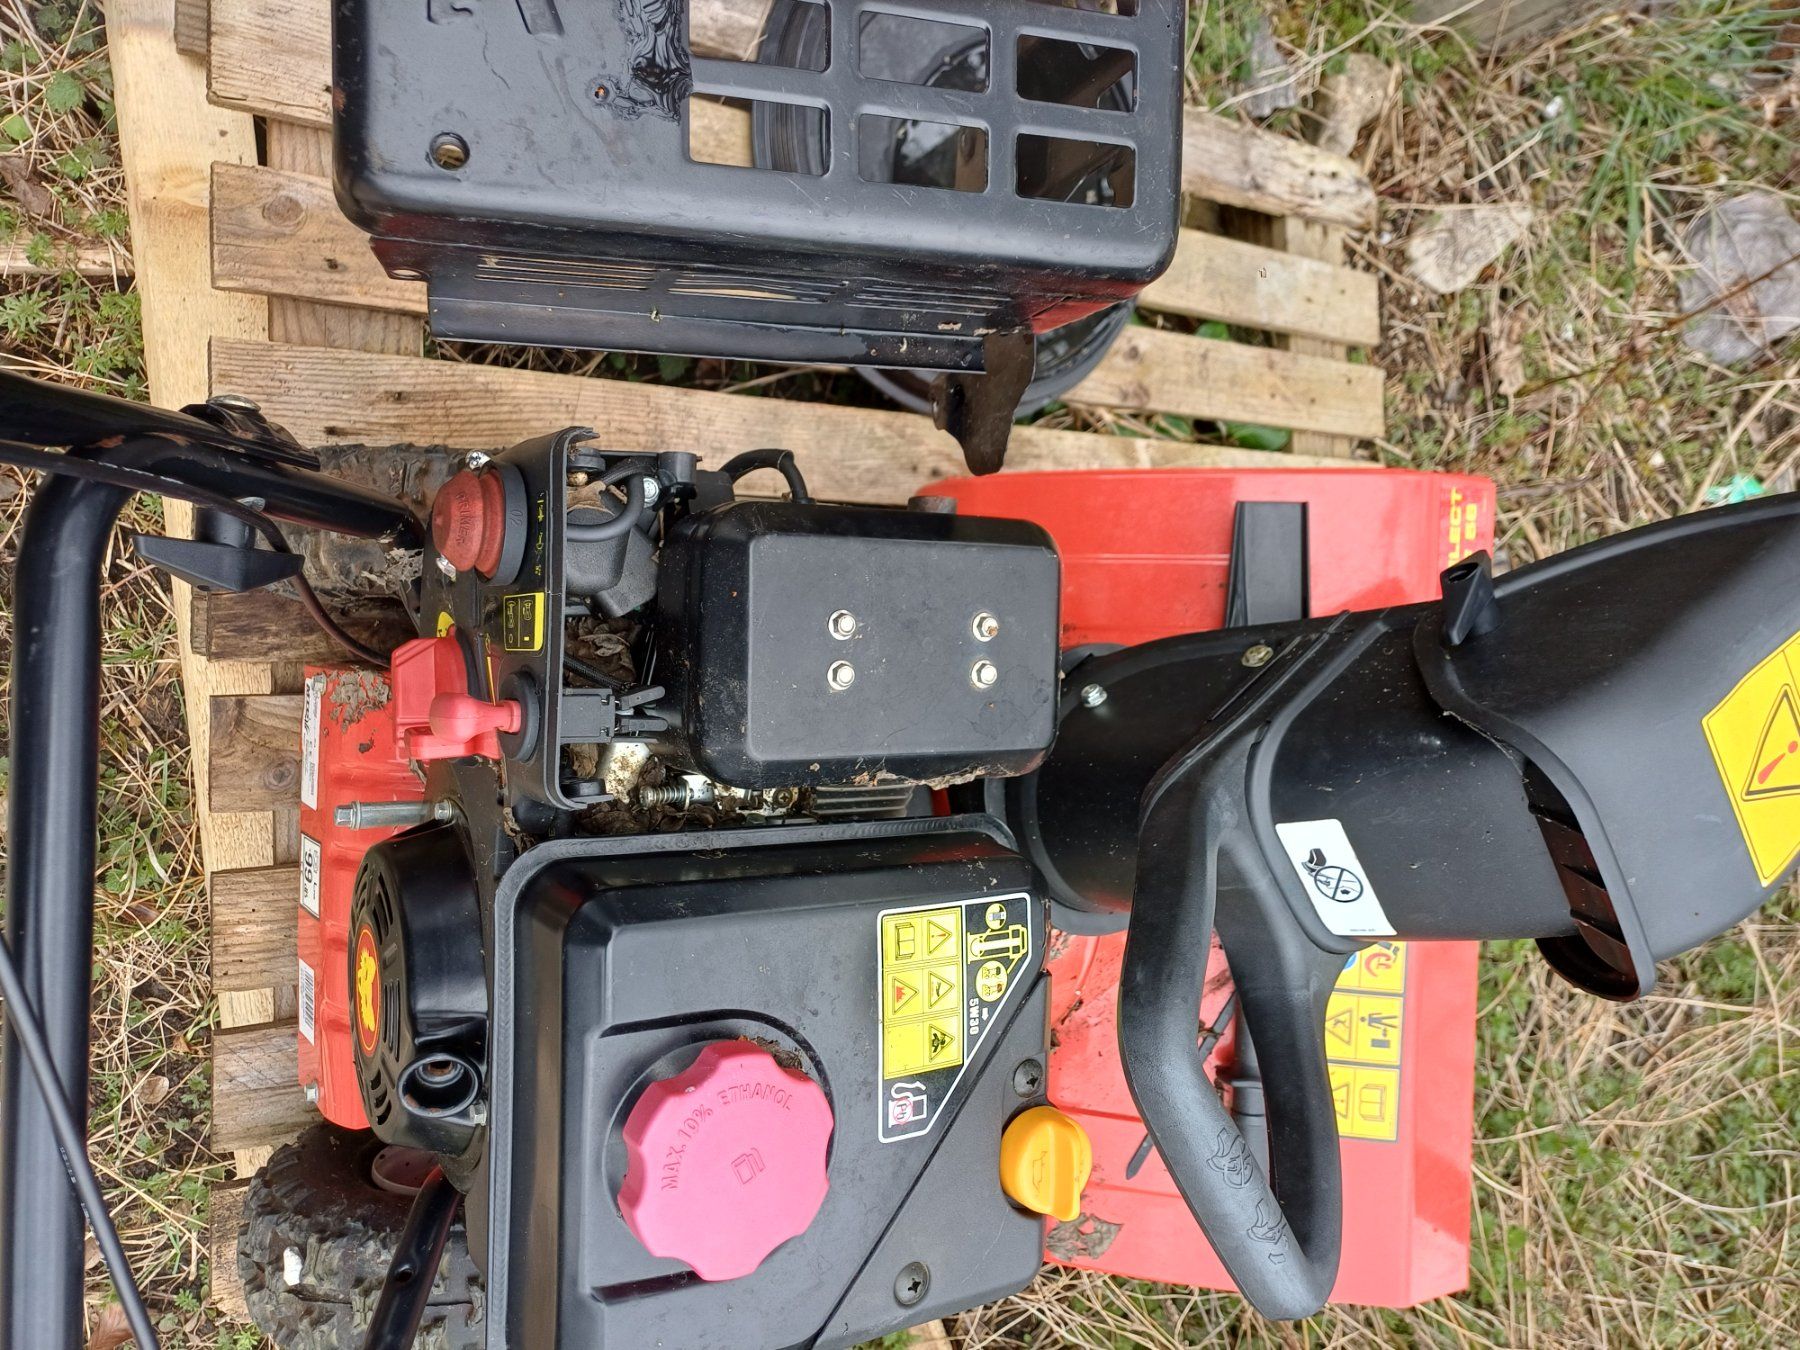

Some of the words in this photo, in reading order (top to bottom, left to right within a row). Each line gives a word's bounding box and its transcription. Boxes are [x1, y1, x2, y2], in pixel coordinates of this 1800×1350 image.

[304, 851, 313, 884] 99
[969, 997, 980, 1035] 5W30
[660, 1144, 686, 1191] MAX.
[678, 1104, 713, 1139] 10%
[717, 1083, 793, 1111] ETHANOL
